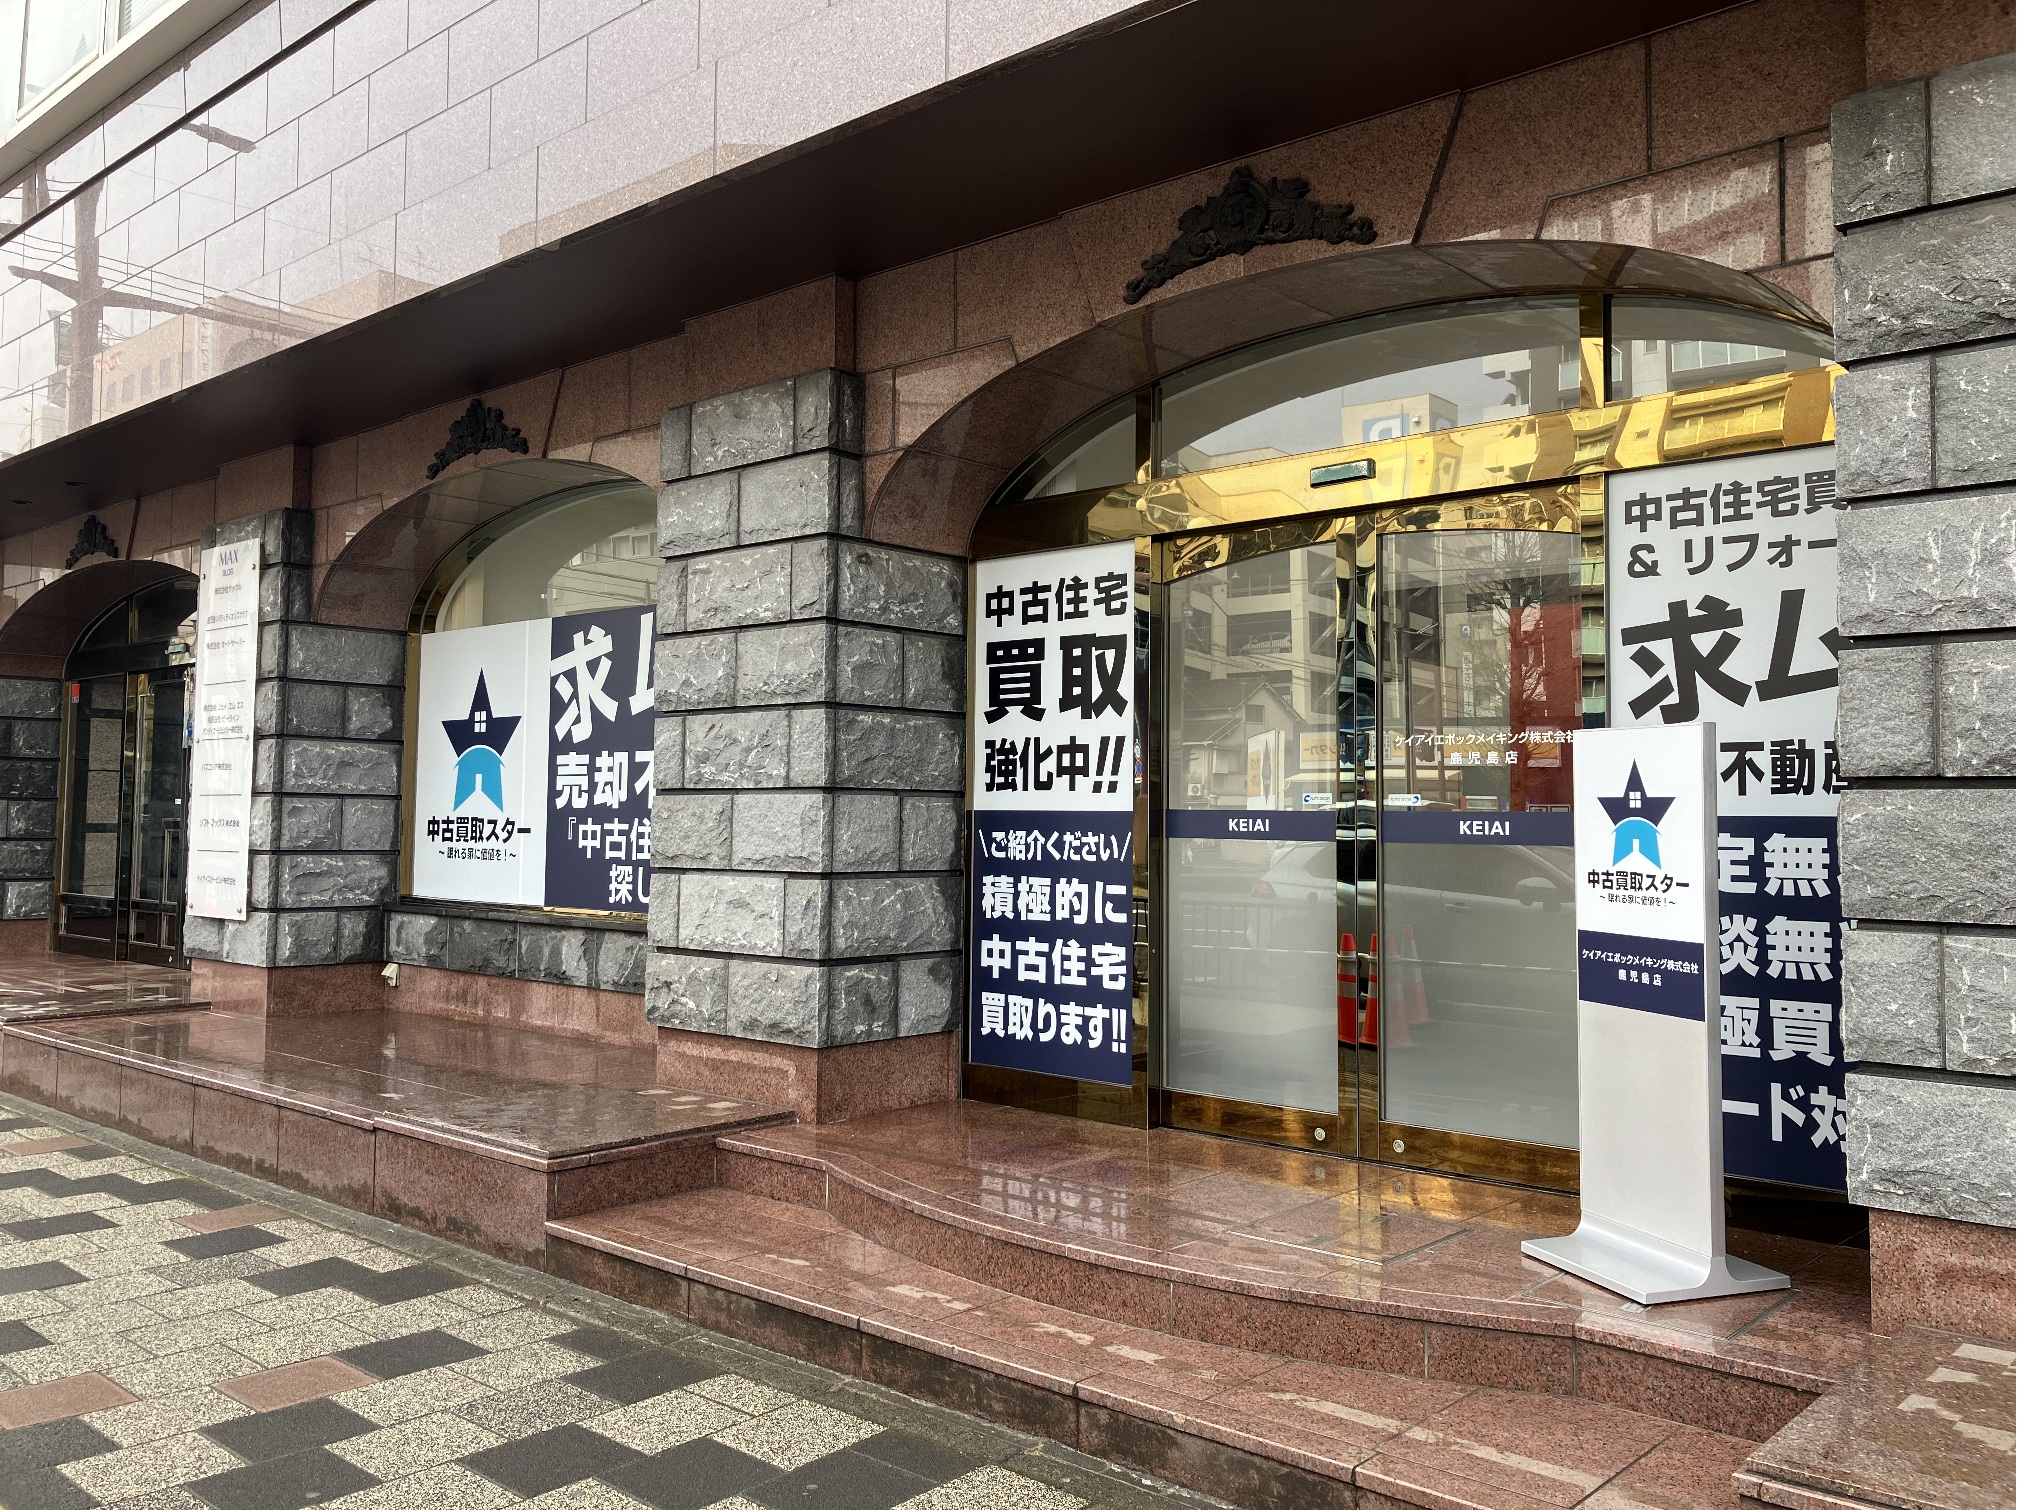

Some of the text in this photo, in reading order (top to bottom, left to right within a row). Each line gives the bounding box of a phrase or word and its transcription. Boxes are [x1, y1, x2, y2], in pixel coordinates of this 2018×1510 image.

[1624, 470, 1849, 533] 中古住宅買
[219, 549, 239, 566] MAX
[1627, 543, 1662, 578] &
[985, 572, 1128, 627] 中古住宅
[983, 633, 1129, 724] 買取
[1620, 588, 1854, 724] 求ム
[985, 735, 1127, 793] 強化中!!
[427, 816, 532, 844] 中古買取スター
[1228, 818, 1270, 832] KEIAI
[1459, 820, 1511, 836] KEIAI
[981, 875, 1128, 925] 積極的に
[1587, 869, 1690, 894] 中古買取スター
[980, 933, 1127, 990] 中古住宅
[980, 991, 1127, 1054] 買取ります!!
